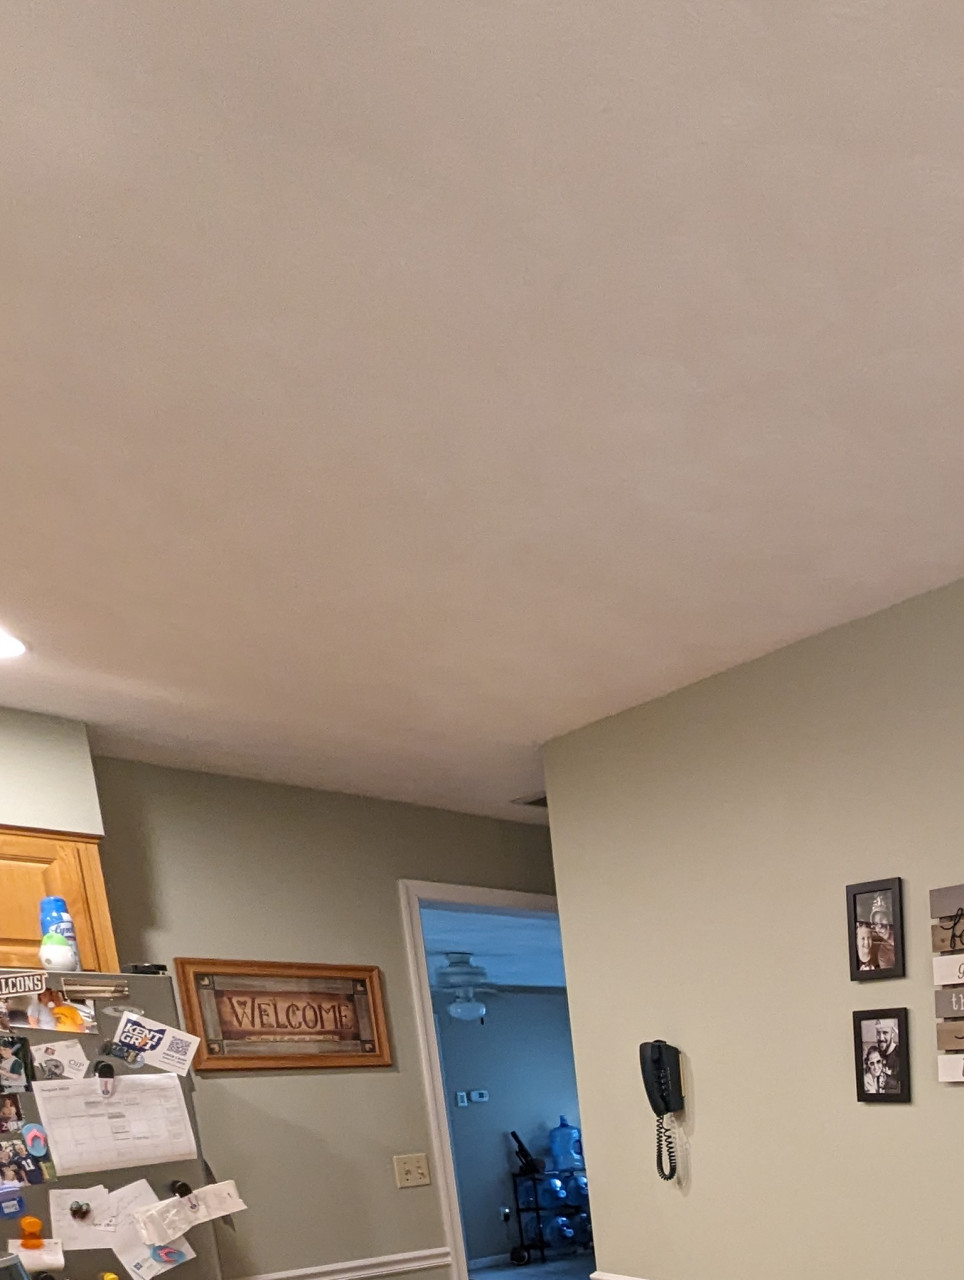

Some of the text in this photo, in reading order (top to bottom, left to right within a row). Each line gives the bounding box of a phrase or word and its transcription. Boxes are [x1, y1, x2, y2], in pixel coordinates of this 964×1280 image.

[0, 975, 42, 995] LCONS
[226, 996, 353, 1030] WELCOME
[123, 1023, 163, 1042] KENT
[21, 1158, 35, 1171] 11
